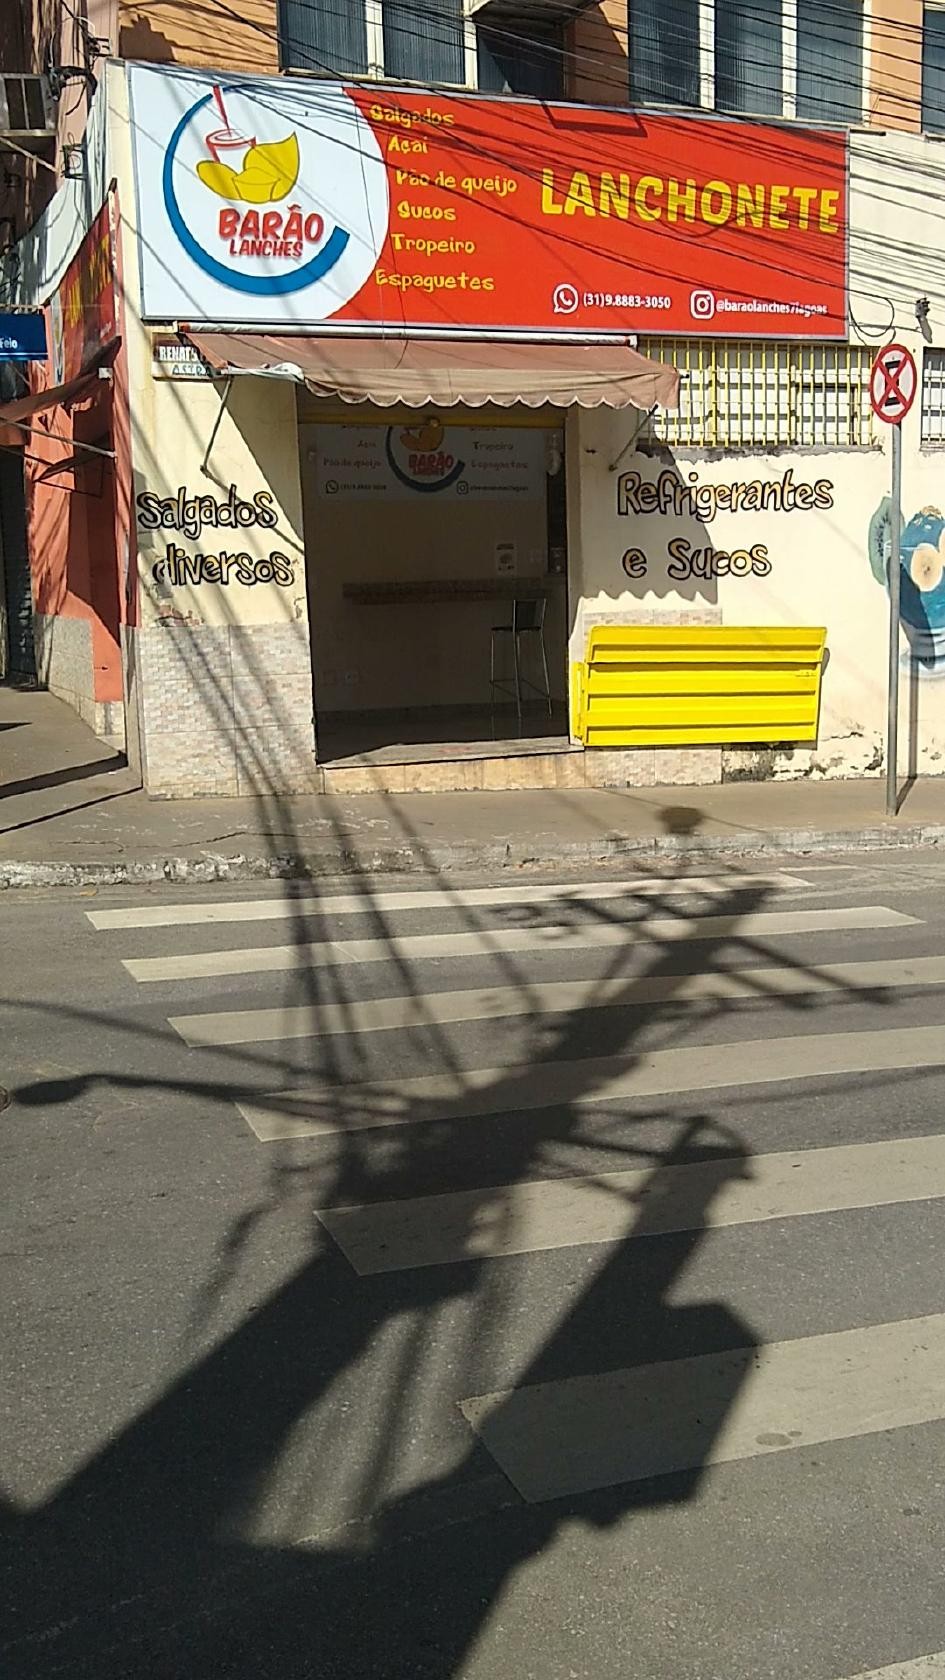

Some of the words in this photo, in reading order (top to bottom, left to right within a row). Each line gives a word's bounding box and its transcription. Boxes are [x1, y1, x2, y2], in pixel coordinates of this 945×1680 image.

[369, 104, 456, 128] Salgados
[396, 169, 429, 187] Pão
[434, 170, 457, 189] de
[461, 175, 518, 198] queijo
[397, 200, 456, 222] Sucos
[541, 167, 841, 234] LANCHONETE
[217, 204, 325, 242] BARÃO
[229, 237, 303, 258] LANCHES
[390, 232, 476, 257] Tropeiro
[375, 268, 496, 293] Espaguetes
[582, 291, 671, 310] (31)9.8883-3050
[616, 468, 834, 523] Refrigerantes
[136, 484, 278, 541] Salgados
[151, 543, 296, 588] diversos
[622, 547, 648, 580] e
[666, 537, 773, 582] Sucos
